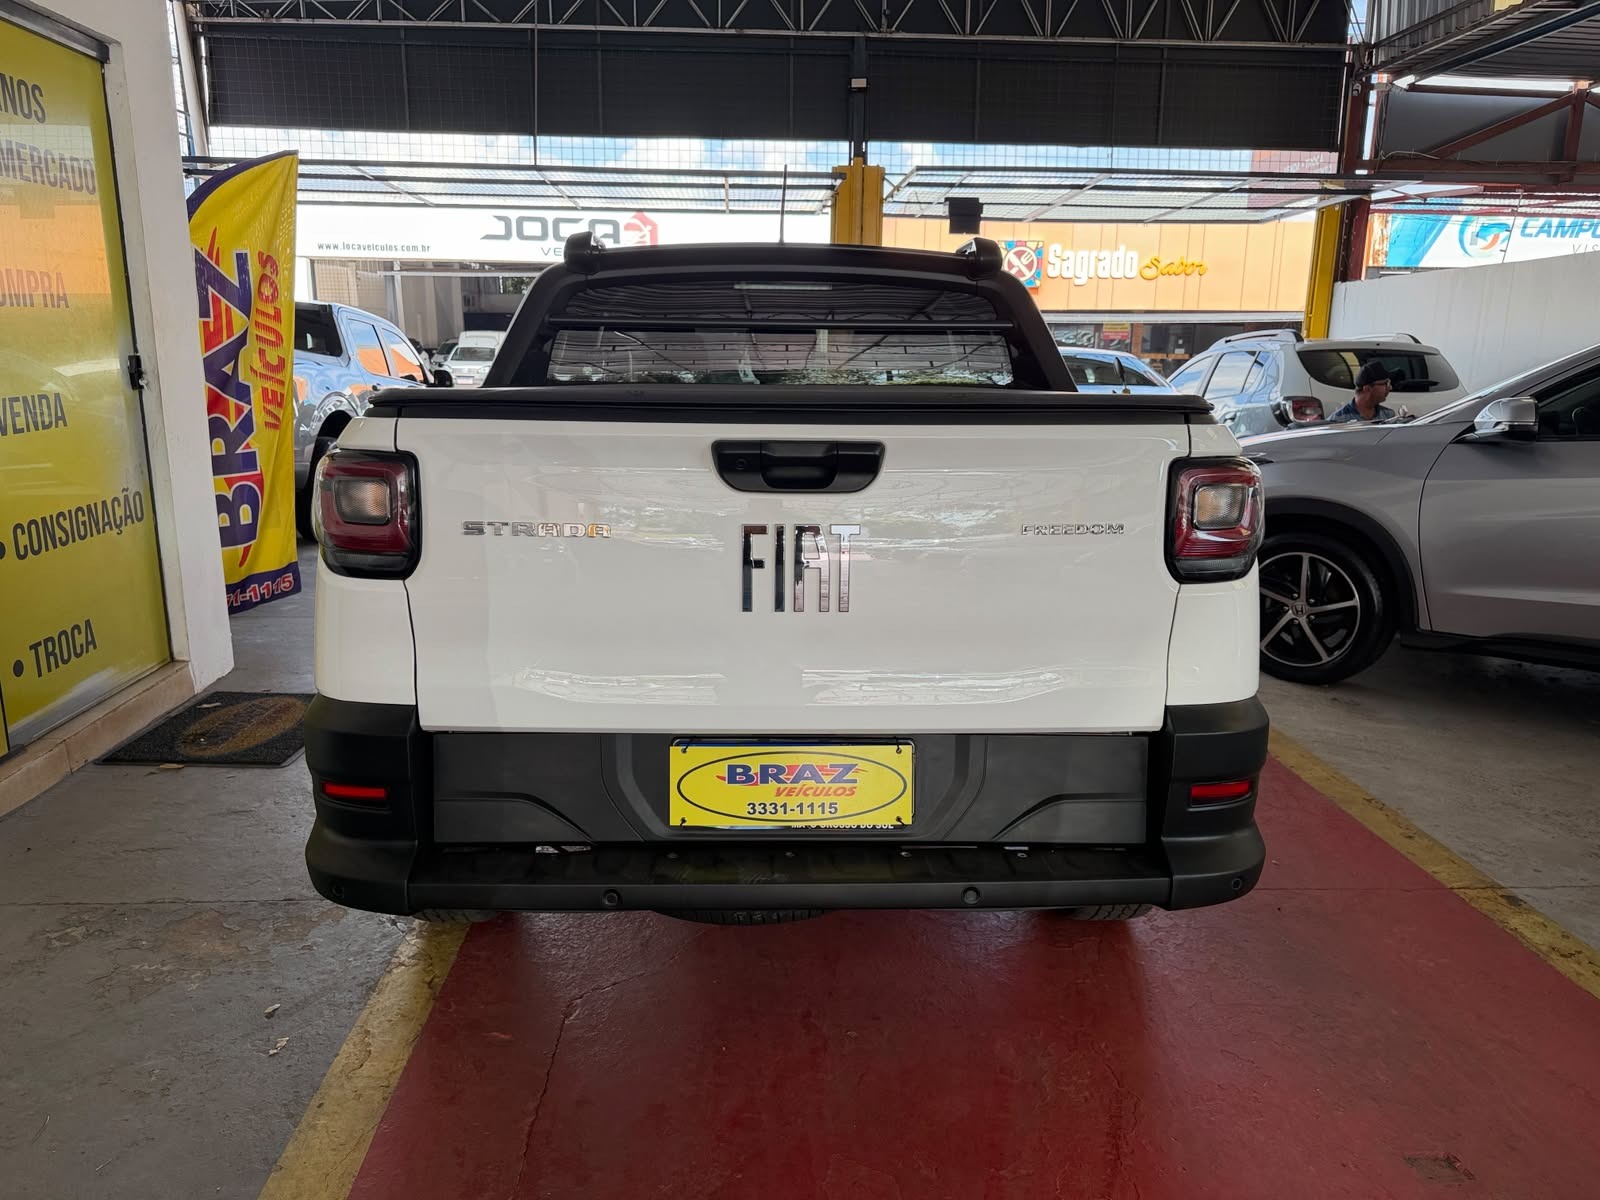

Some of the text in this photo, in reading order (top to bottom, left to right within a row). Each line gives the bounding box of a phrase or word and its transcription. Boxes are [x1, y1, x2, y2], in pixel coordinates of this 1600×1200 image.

[1047, 243, 1208, 286] Sagrado Sabor
[250, 249, 287, 431] VEÍCULOS
[0, 392, 68, 437] VENDA
[194, 247, 262, 549] BRAZ
[12, 487, 145, 561] CONSIGNAÇÃO
[463, 521, 612, 539] STRADA
[1021, 523, 1125, 536] FREEDOM
[741, 523, 861, 613] FIAT
[29, 618, 97, 679] TROCA
[726, 763, 860, 785] BRAZ
[775, 785, 857, 797] VEÍCULOS
[746, 801, 839, 816] 3331-1115
